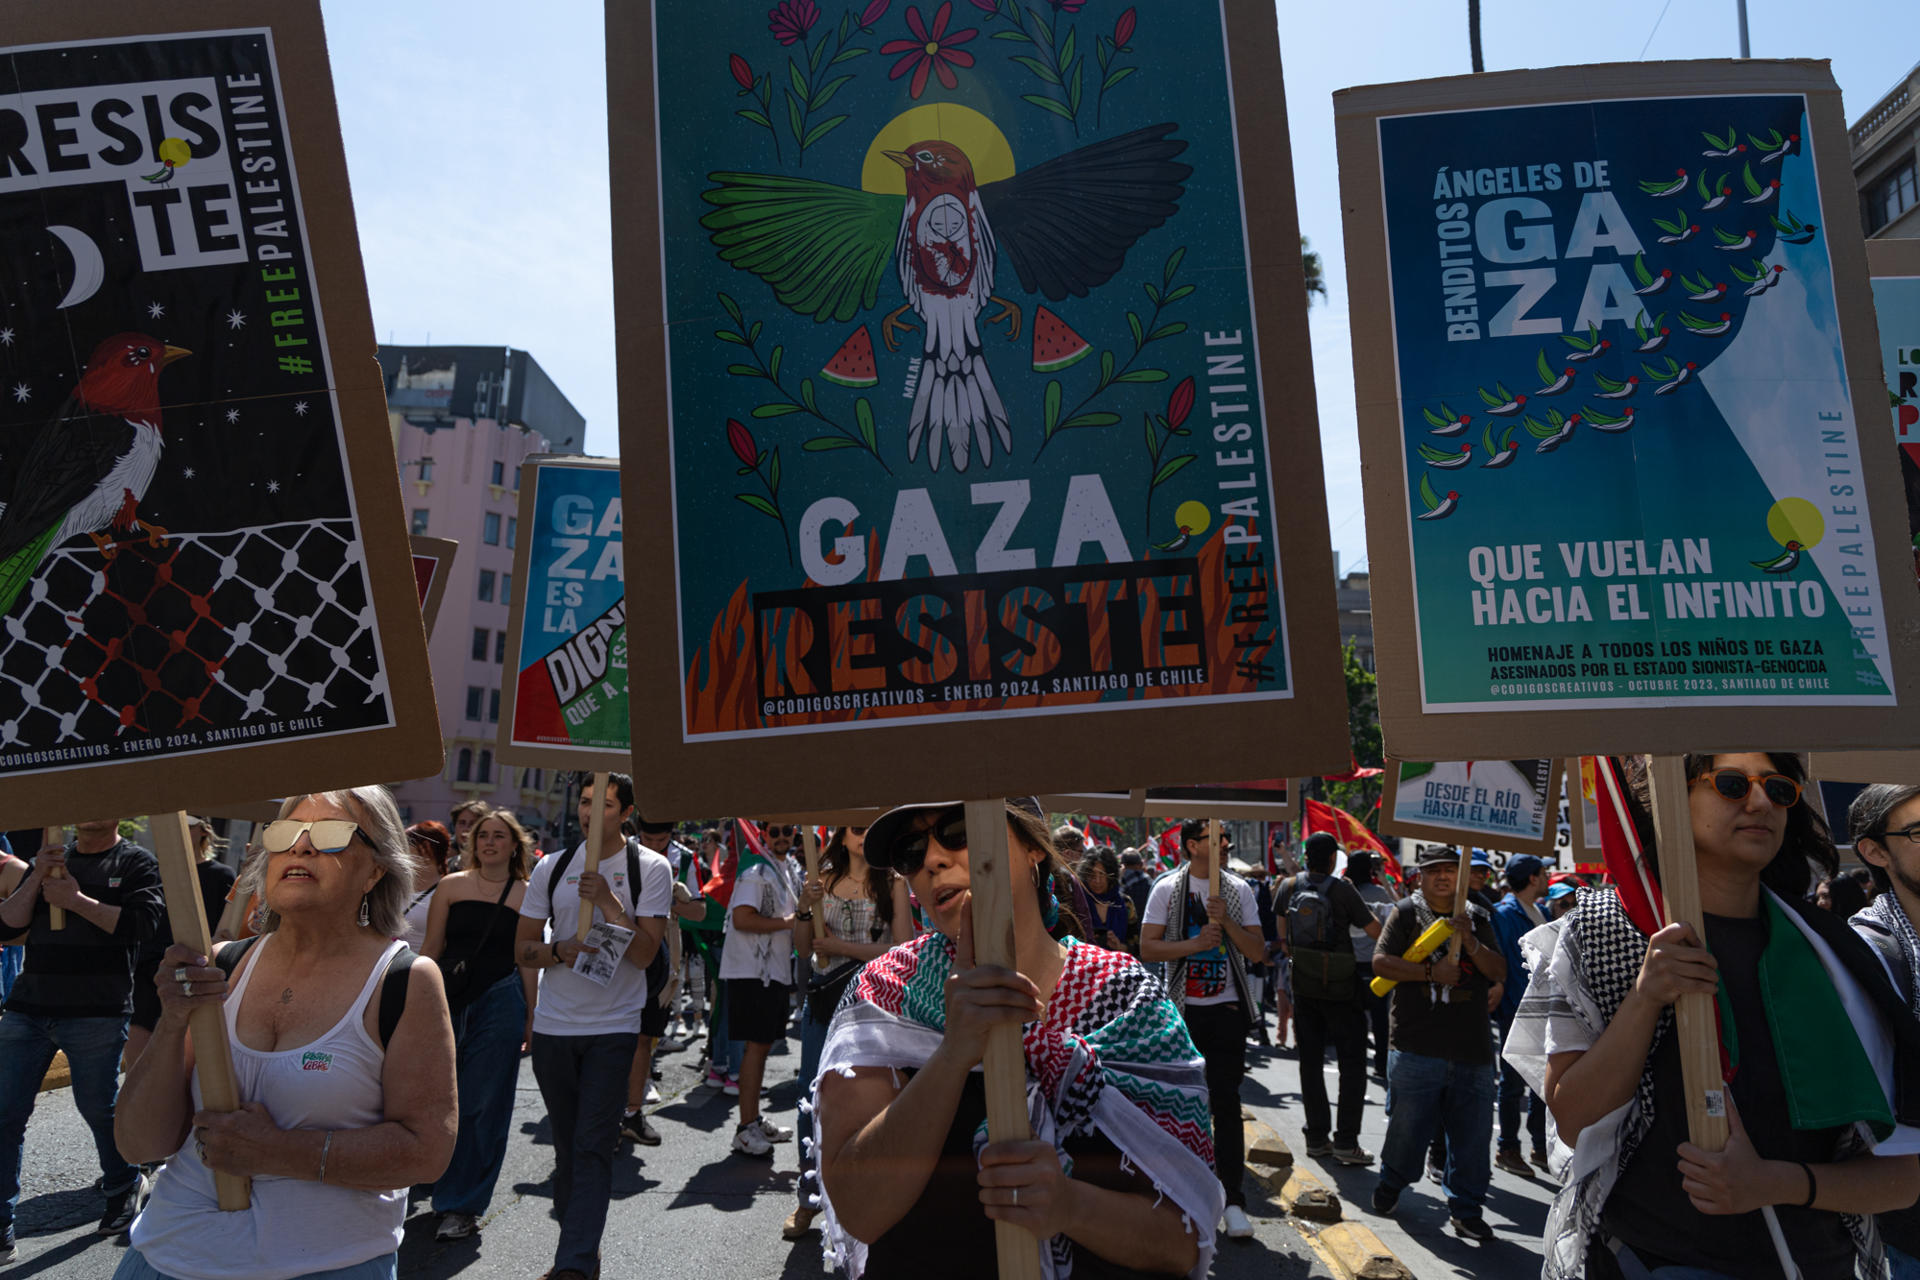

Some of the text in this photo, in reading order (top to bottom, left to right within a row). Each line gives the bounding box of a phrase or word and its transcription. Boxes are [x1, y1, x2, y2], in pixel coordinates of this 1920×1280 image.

[0, 92, 221, 178] RESIS
[1433, 160, 1611, 200] ÁNGELES DE
[133, 183, 241, 257] TE
[1475, 191, 1646, 264] GA
[1435, 202, 1481, 342] BENDITOS
[1484, 263, 1655, 338] ZA
[902, 357, 922, 399] MALAK
[799, 473, 1134, 587] GAZA
[1468, 538, 1713, 588] QUE VUELAN
[546, 581, 584, 608] ES
[1471, 580, 1826, 626] HACIA EL INFINITO
[542, 607, 578, 634] LA
[760, 574, 1200, 698] RESISTE
[1488, 637, 1824, 662] HOMENAJE A TODOS LOS NIÑOS DE GAZA
[1490, 659, 1827, 680] ASESINADOS POR EL ESTADO SIONISTA-GENOCIDA
[565, 692, 601, 727] QUE
[602, 680, 618, 700] A
[764, 688, 925, 716] @CODIGOSCREATIVOS
[944, 683, 993, 701] ENERO
[1000, 680, 1047, 698] 2024,
[1052, 673, 1129, 693] SANTIAGO
[1135, 671, 1154, 688] DE
[1160, 668, 1204, 686] CHILE
[1490, 681, 1614, 695] @CODIGOSCREATIVOS
[1628, 679, 1679, 692] OCTUBRE
[1684, 679, 1718, 692] 2023,
[1722, 678, 1776, 690] SANTIAGO
[1781, 678, 1794, 689] DE
[1798, 678, 1830, 689] CHILE
[123, 737, 162, 753] ENERO
[166, 732, 203, 748] 2024,
[206, 723, 266, 742] SANTIAGO
[270, 721, 285, 734] DE
[289, 716, 325, 731] CHILE
[1422, 799, 1466, 820] HASTA
[1470, 805, 1484, 823] EL
[1489, 808, 1518, 827] MAR
[1424, 781, 1521, 809] DESDE EL RÍO
[1189, 962, 1226, 979] ESIS
